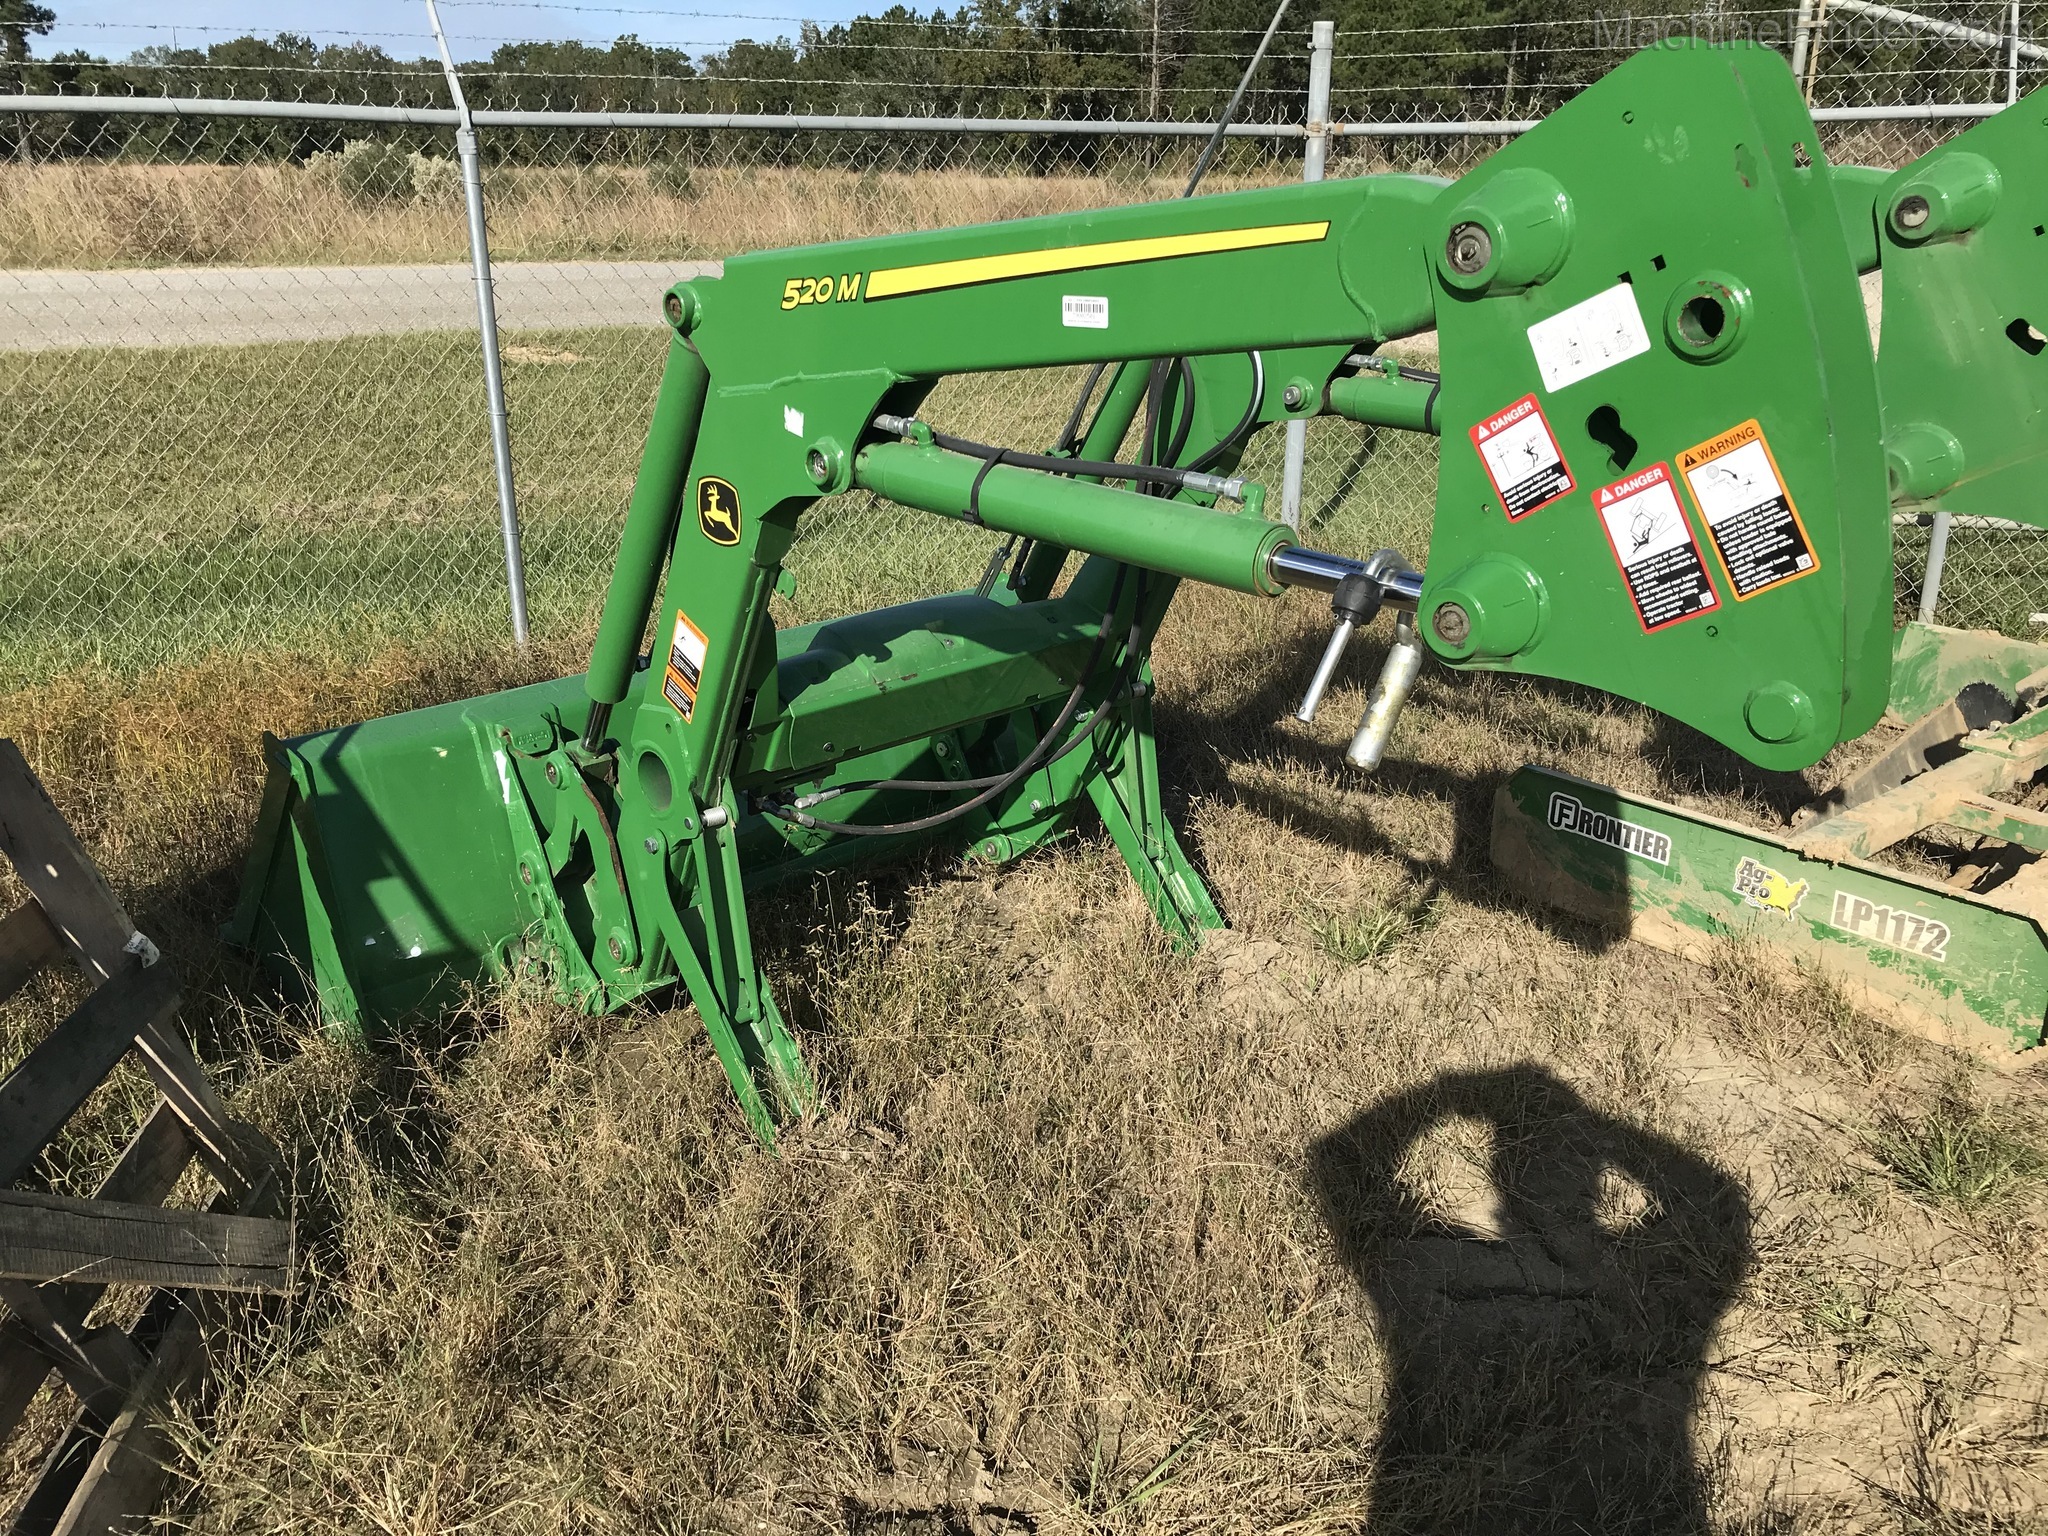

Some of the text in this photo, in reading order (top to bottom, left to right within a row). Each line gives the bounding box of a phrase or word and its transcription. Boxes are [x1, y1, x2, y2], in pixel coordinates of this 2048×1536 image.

[781, 272, 863, 311] 520 M
[1490, 401, 1533, 432] DANGER
[1697, 426, 1755, 460] WARNING
[1613, 468, 1663, 497] DANGER
[1722, 517, 1737, 527] avoid
[1737, 511, 1753, 520] injury
[1761, 500, 1777, 510] death
[1738, 524, 1757, 535] handle
[1757, 516, 1774, 527] round
[1773, 510, 1789, 520] bales
[1741, 531, 1759, 541] loader
[1765, 515, 1792, 530] equipped
[1628, 562, 1647, 572] Serious
[1647, 556, 1662, 565] injury
[1670, 547, 1684, 556] death
[1660, 567, 1670, 575] and
[1736, 569, 1756, 580] Handle
[1773, 555, 1790, 564] loads
[1639, 590, 1649, 598] Add
[1641, 596, 1655, 604] Move
[1741, 584, 1756, 593] Carry
[1550, 794, 1669, 862] FRONTIER
[1739, 861, 1773, 883] Ag-
[1737, 877, 1770, 898] Pro
[1833, 894, 1948, 959] LP1172
